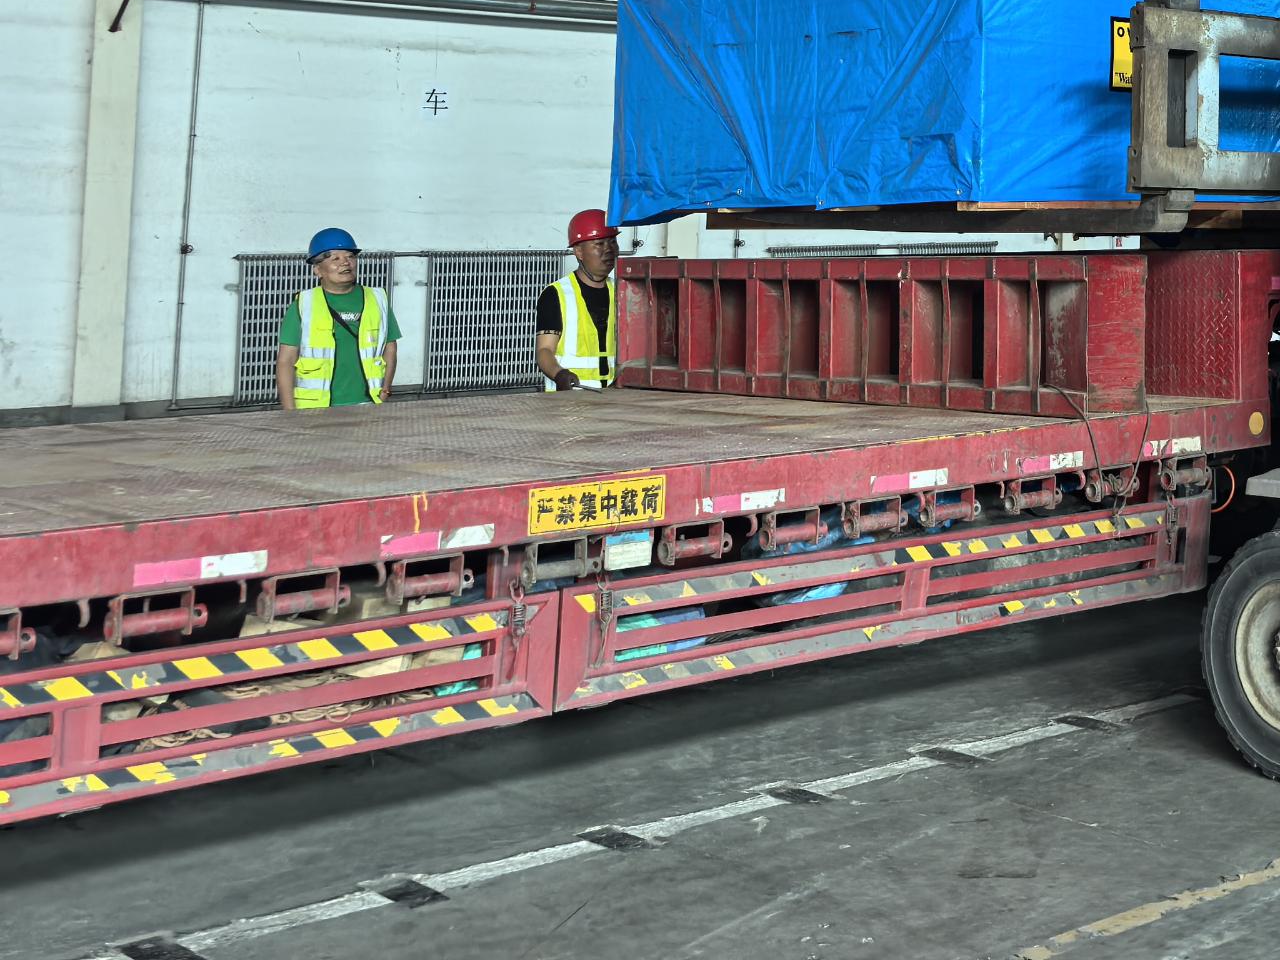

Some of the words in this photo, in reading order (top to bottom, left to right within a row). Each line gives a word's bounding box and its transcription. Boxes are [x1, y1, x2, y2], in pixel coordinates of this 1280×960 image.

[422, 89, 448, 115] 车
[536, 485, 661, 525] 严禁集中载荷
